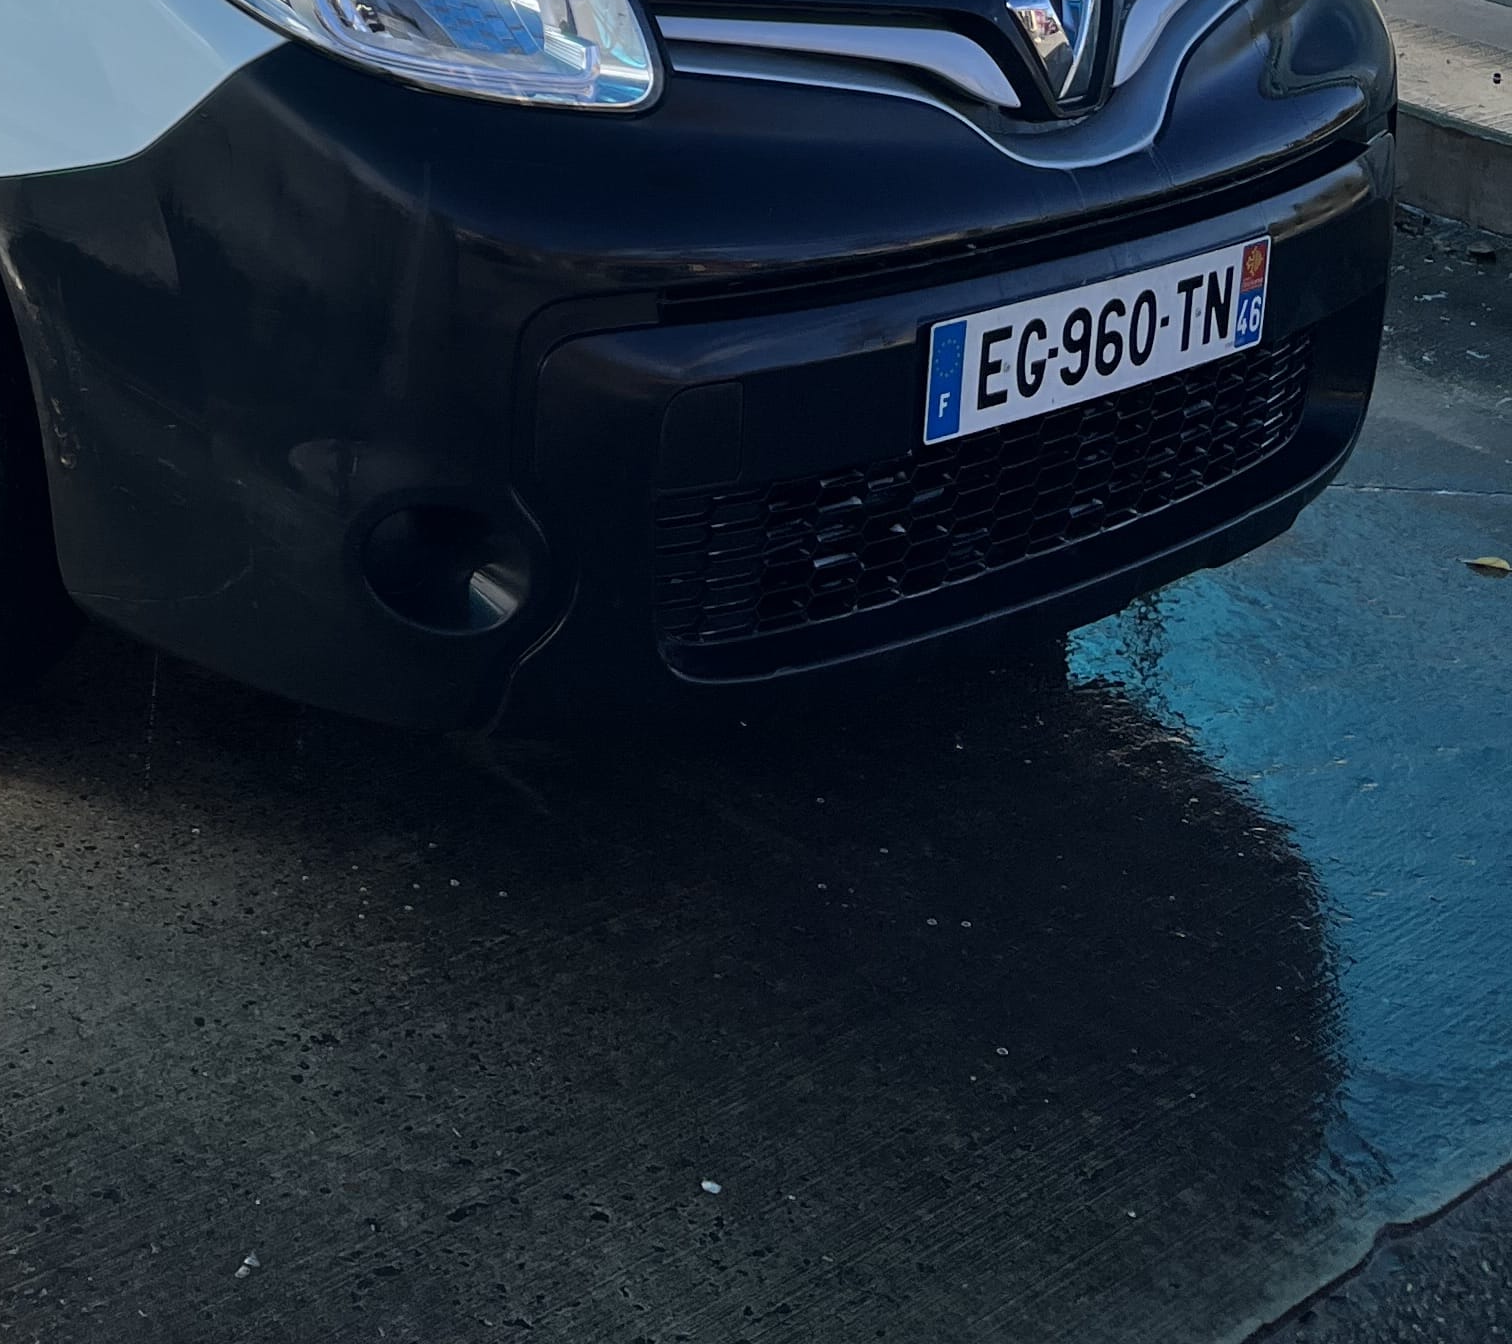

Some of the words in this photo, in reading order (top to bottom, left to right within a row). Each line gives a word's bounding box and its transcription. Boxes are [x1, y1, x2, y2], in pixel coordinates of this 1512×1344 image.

[938, 391, 951, 419] F
[977, 265, 1235, 411] EG-960-TN
[1236, 295, 1262, 335] 46
